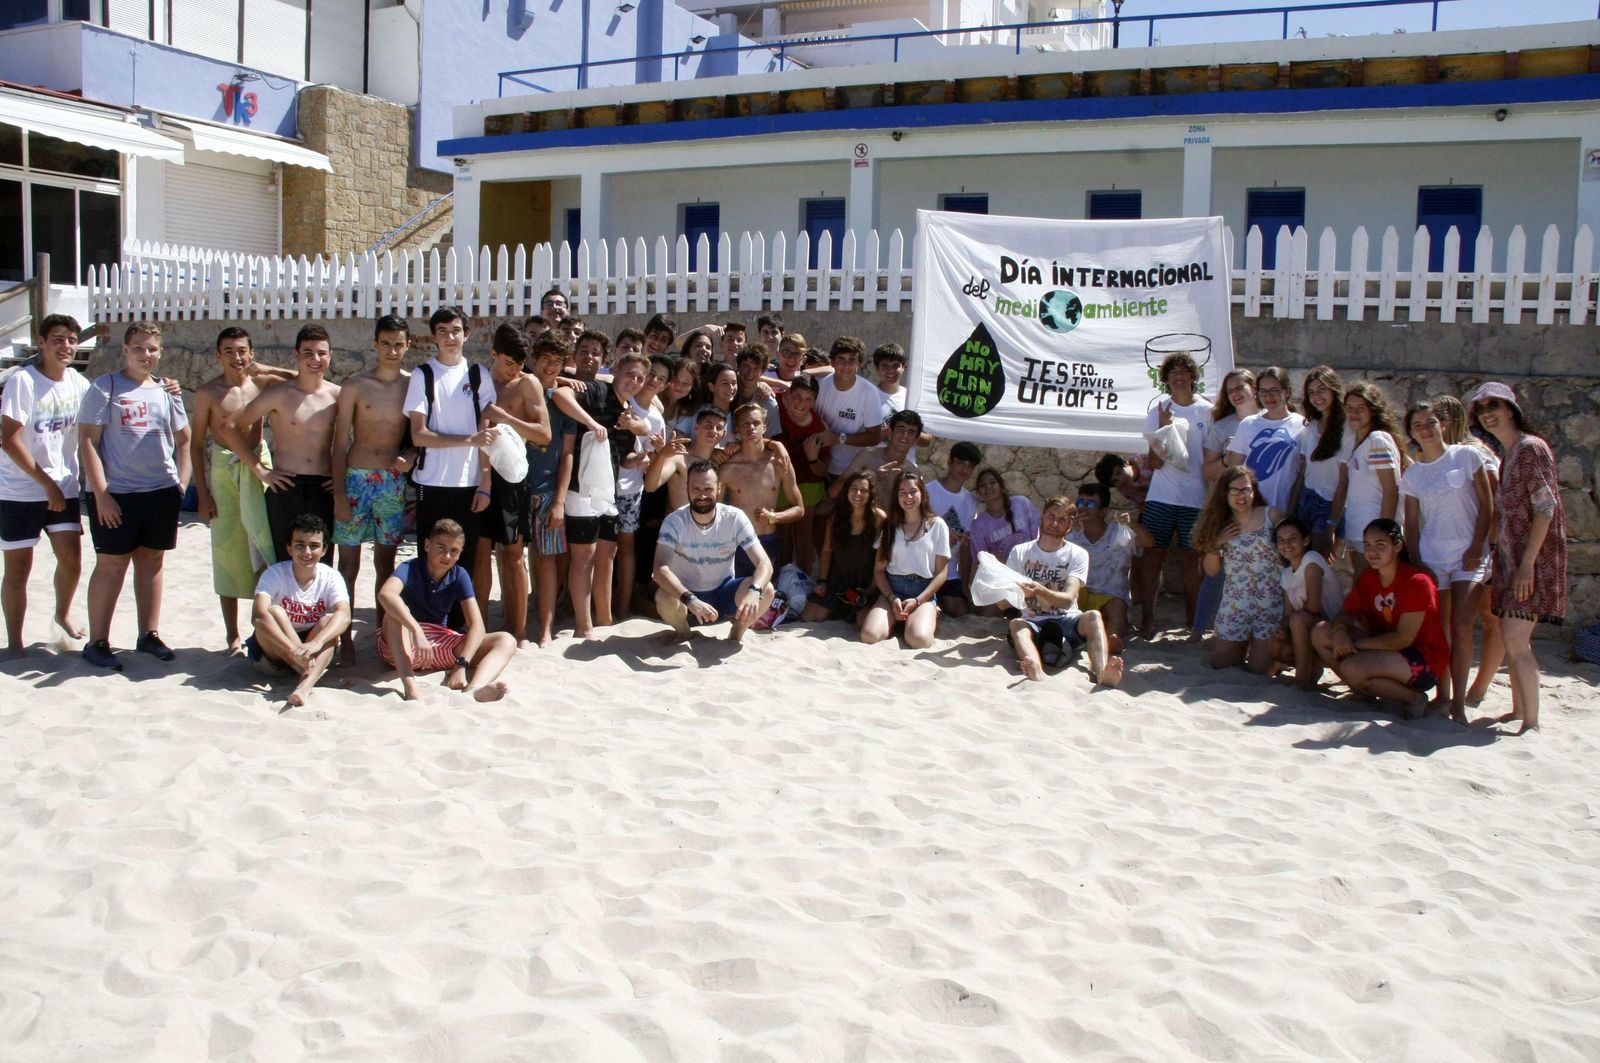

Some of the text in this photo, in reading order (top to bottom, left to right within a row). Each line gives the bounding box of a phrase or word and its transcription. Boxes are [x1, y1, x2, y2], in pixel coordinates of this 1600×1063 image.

[1188, 125, 1206, 133] ZONA
[1184, 136, 1210, 144] PRIVADA
[962, 276, 990, 300] del
[1083, 297, 1168, 319] ambiente
[959, 354, 999, 375] HAY
[1020, 357, 1098, 385] IES FCO.
[943, 368, 992, 395] PLAN
[1071, 376, 1114, 390] JAVIER
[972, 395, 987, 415] B
[1040, 569, 1061, 581] ARE
[281, 596, 327, 614] STRAR
